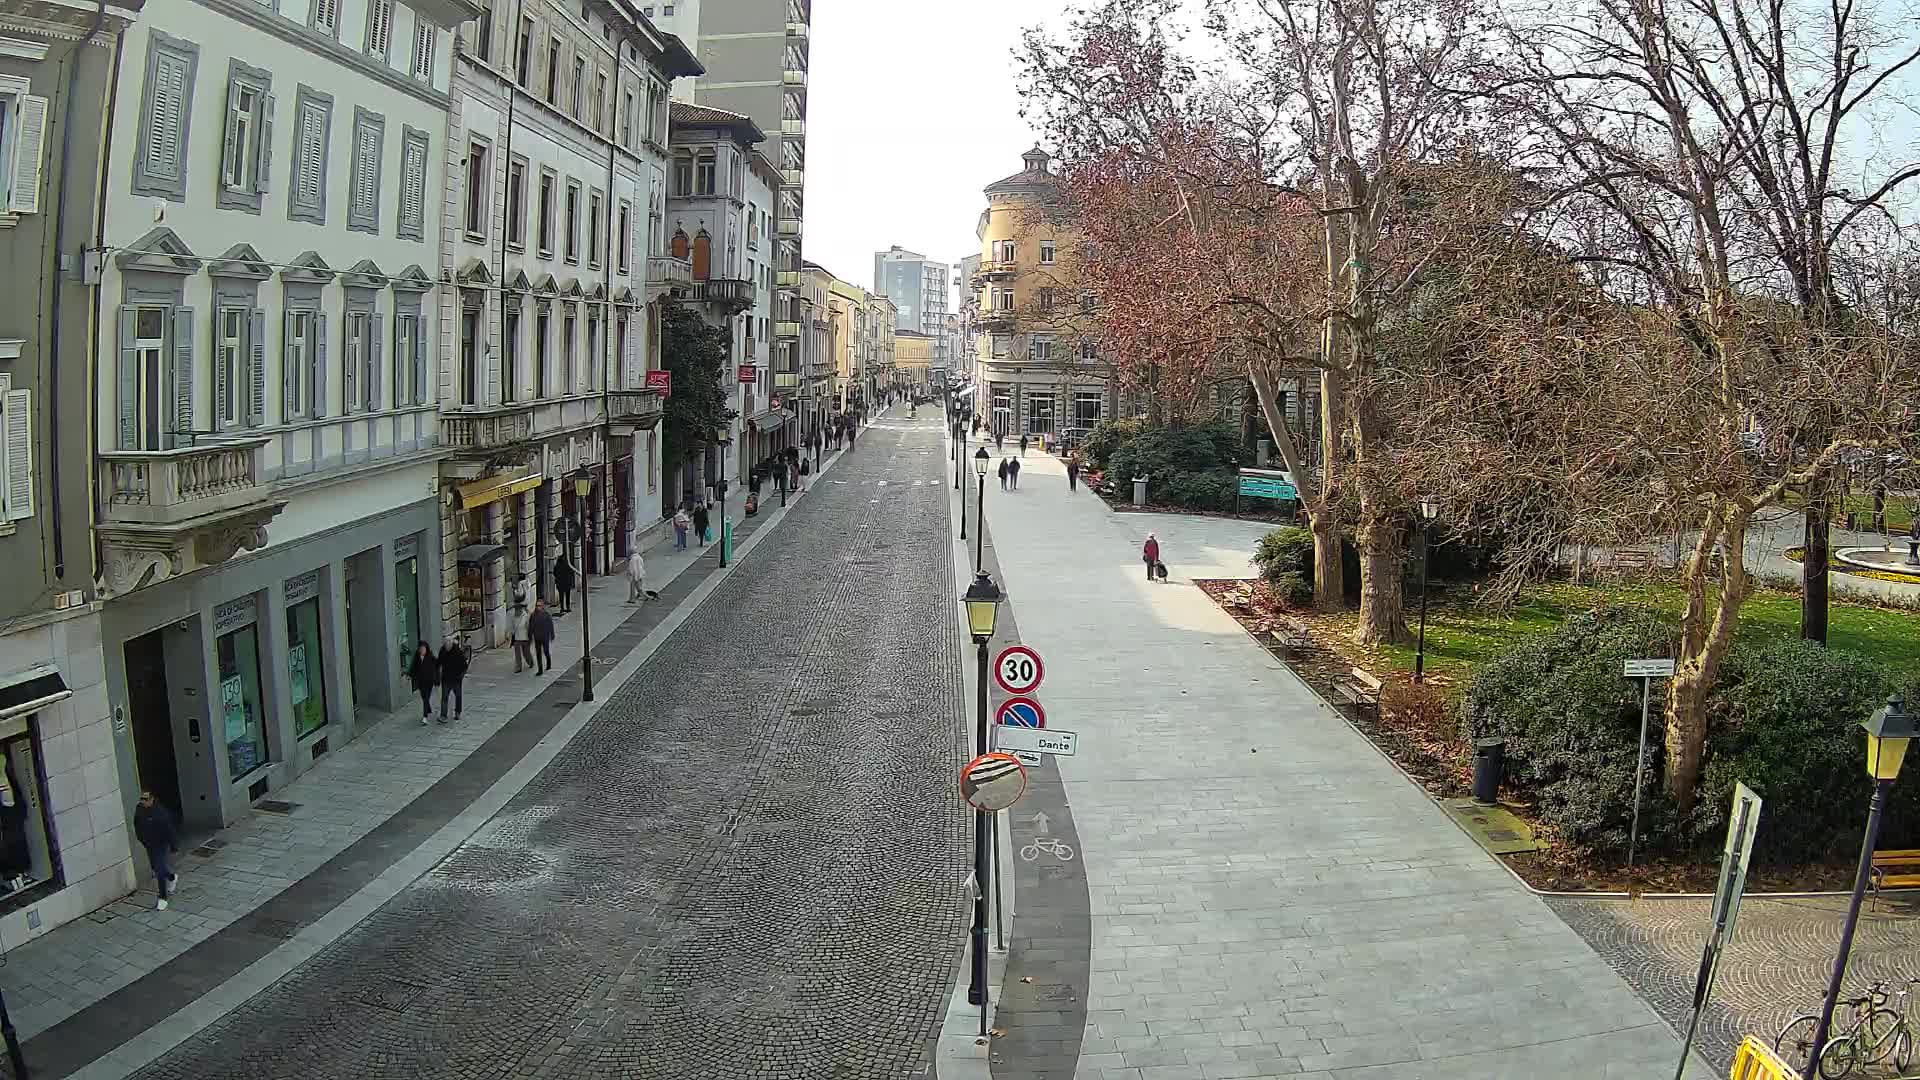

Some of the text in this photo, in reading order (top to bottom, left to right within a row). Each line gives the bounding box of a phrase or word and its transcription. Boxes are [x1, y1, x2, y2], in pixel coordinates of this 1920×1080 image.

[1006, 659, 1033, 681] 30
[223, 679, 241, 702] 130
[1038, 739, 1070, 750] Dante
